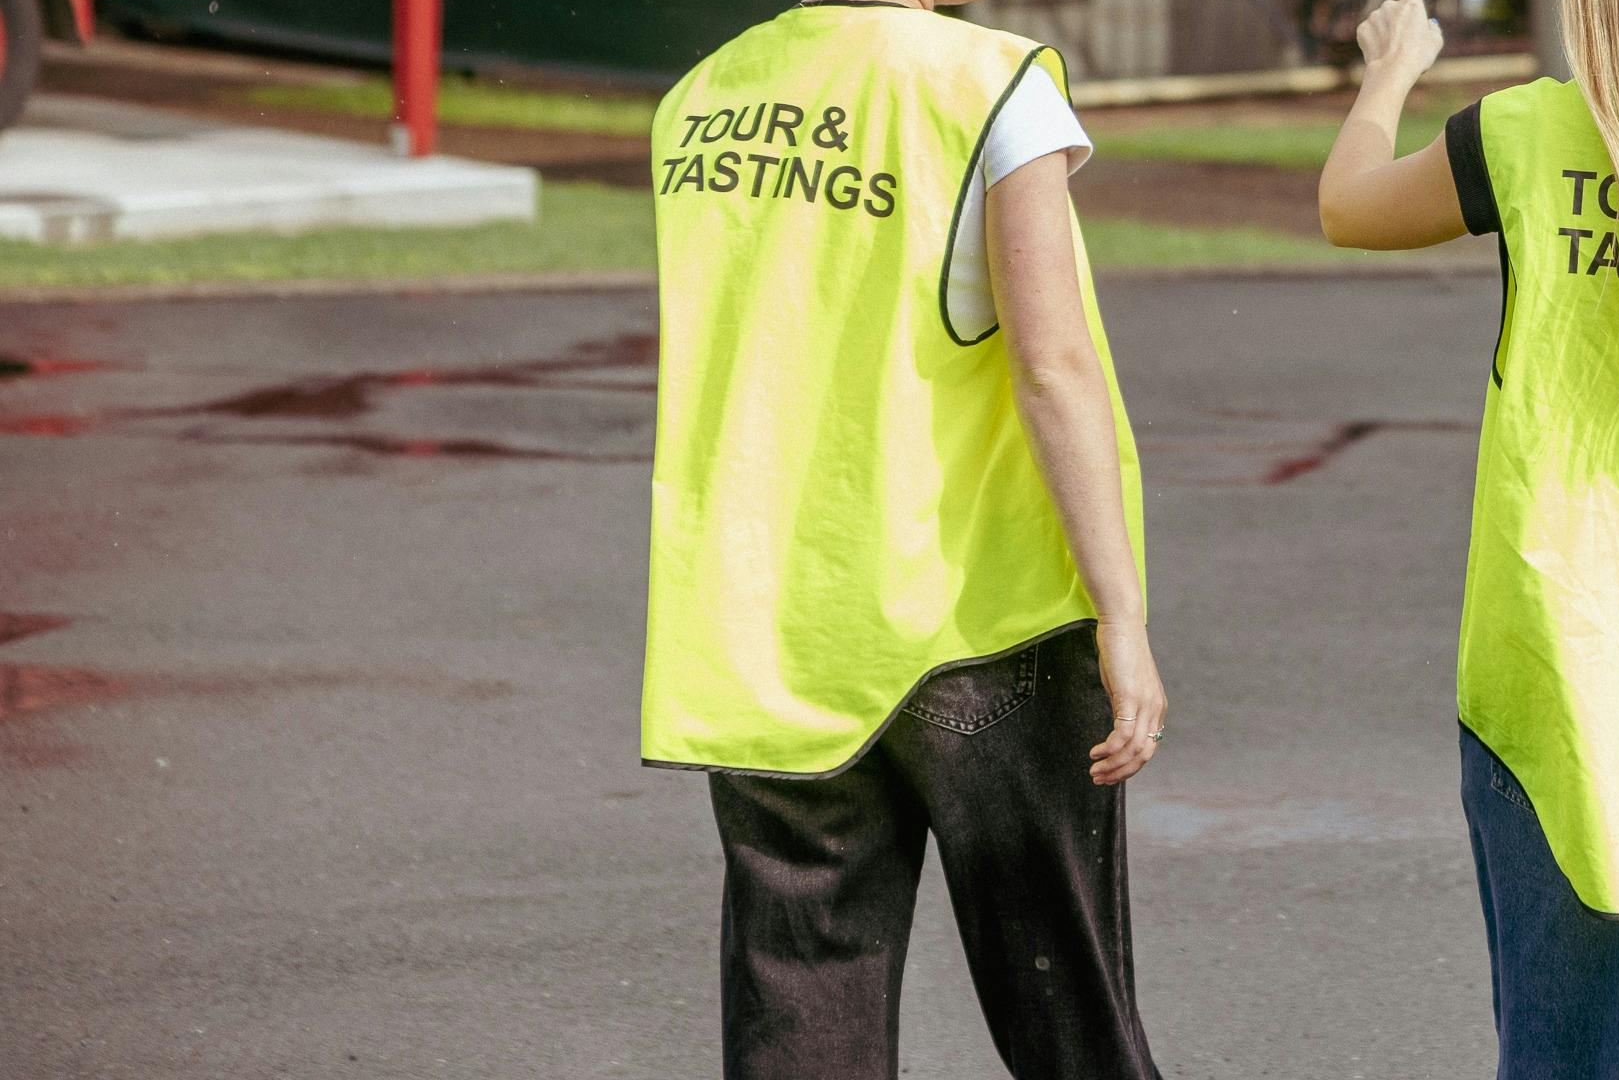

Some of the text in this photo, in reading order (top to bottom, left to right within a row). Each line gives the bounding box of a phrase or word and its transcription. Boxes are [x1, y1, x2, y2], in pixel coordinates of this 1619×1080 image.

[679, 102, 849, 153] TOUR &
[659, 151, 897, 218] TASTINGS
